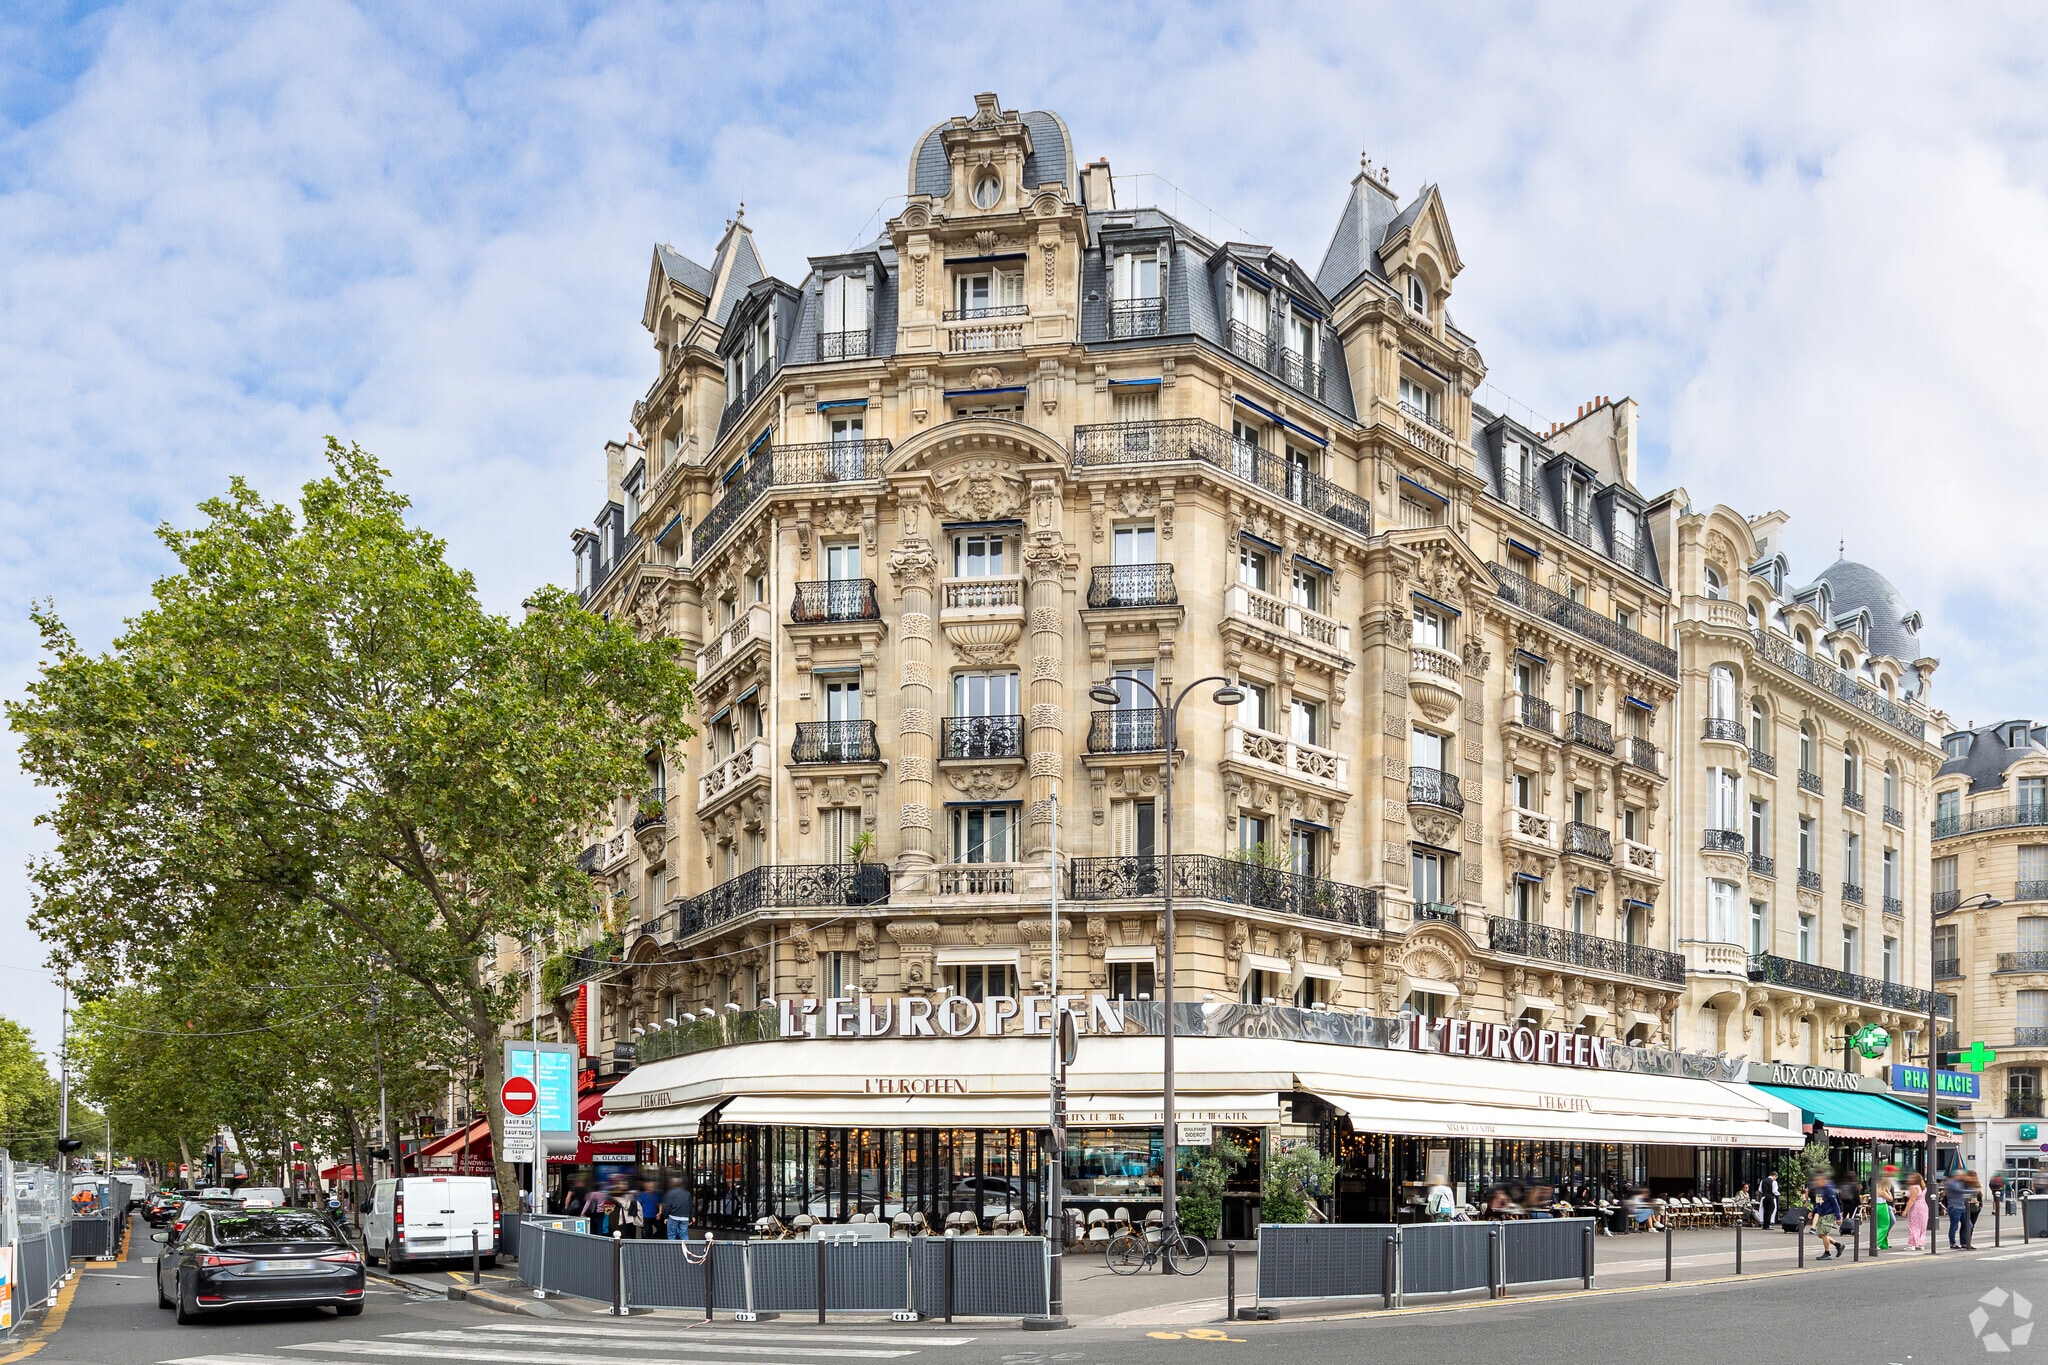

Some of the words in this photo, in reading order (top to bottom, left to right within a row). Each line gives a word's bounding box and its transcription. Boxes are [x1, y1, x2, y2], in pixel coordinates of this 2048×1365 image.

[779, 993, 1124, 1036] L'EUROPEEN
[1415, 1014, 1607, 1068] L'EUROPEEN
[865, 1078, 968, 1094] L'EUROPEEN
[1772, 1065, 1799, 1084] AUX
[1803, 1068, 1858, 1090] CADRANS
[1903, 1069, 1973, 1094] PHAMACIE
